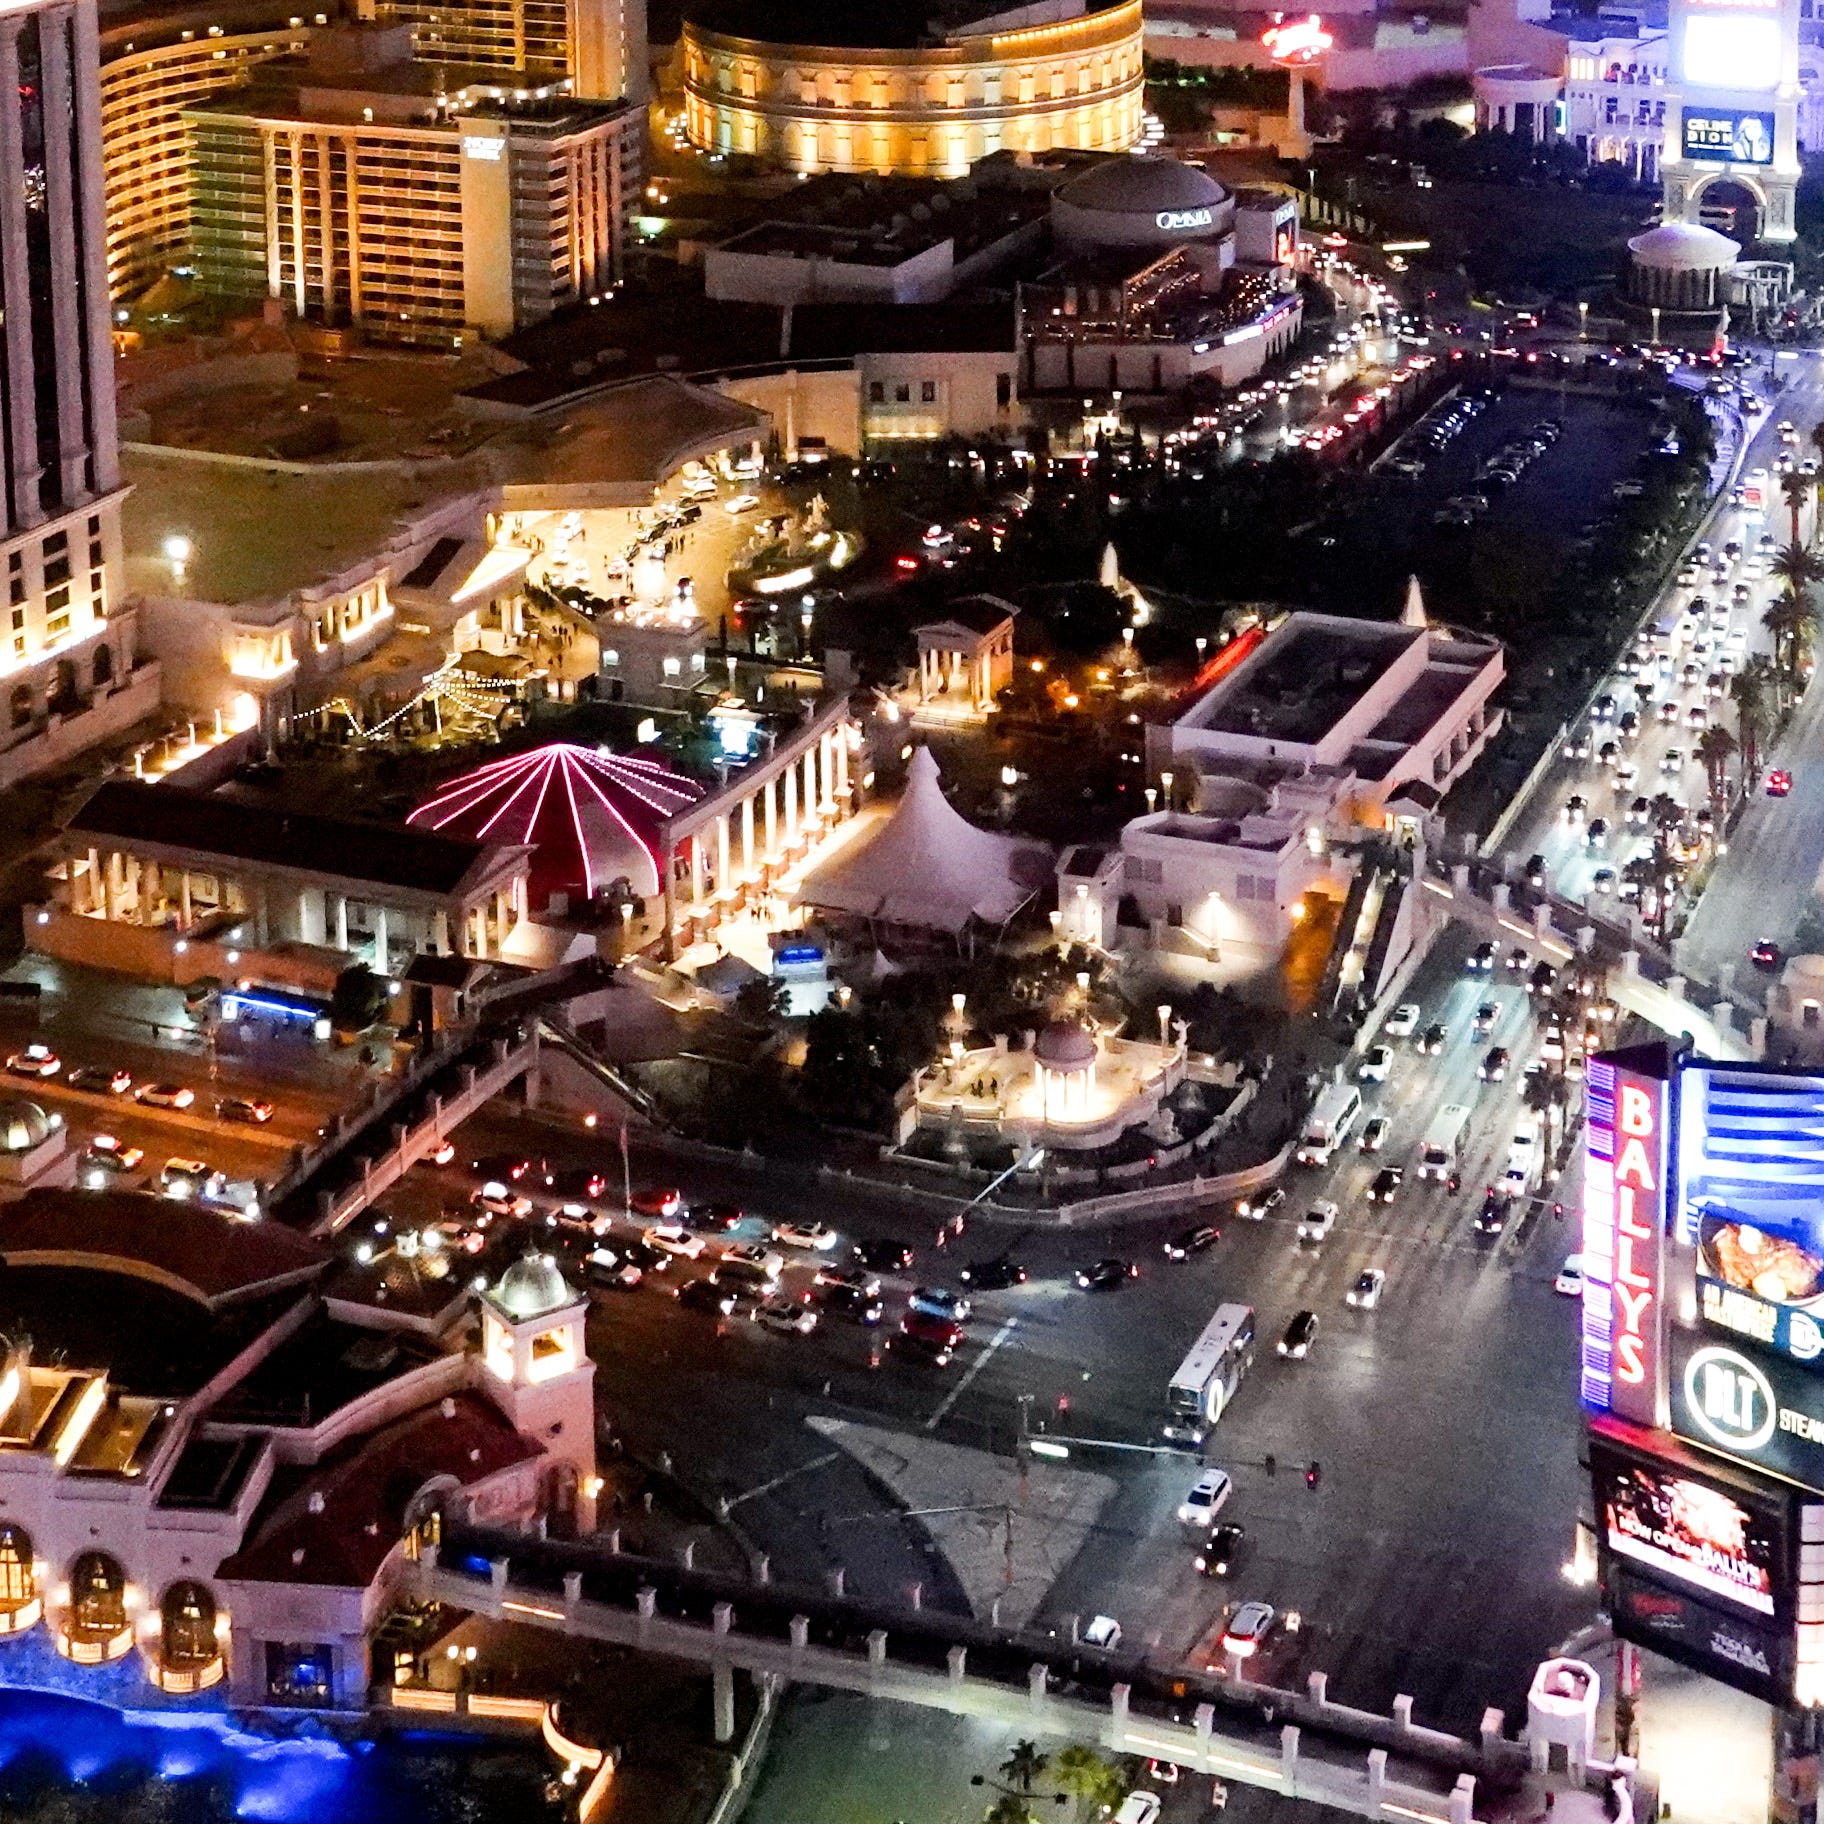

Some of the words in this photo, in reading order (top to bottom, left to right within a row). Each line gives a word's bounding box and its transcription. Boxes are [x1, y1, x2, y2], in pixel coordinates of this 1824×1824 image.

[1687, 118, 1733, 133] CELINE
[1687, 130, 1733, 144] DION
[1155, 209, 1213, 230] OMNIA
[1704, 1363, 1759, 1431] BLT
[1619, 1515, 1653, 1540] NOW
